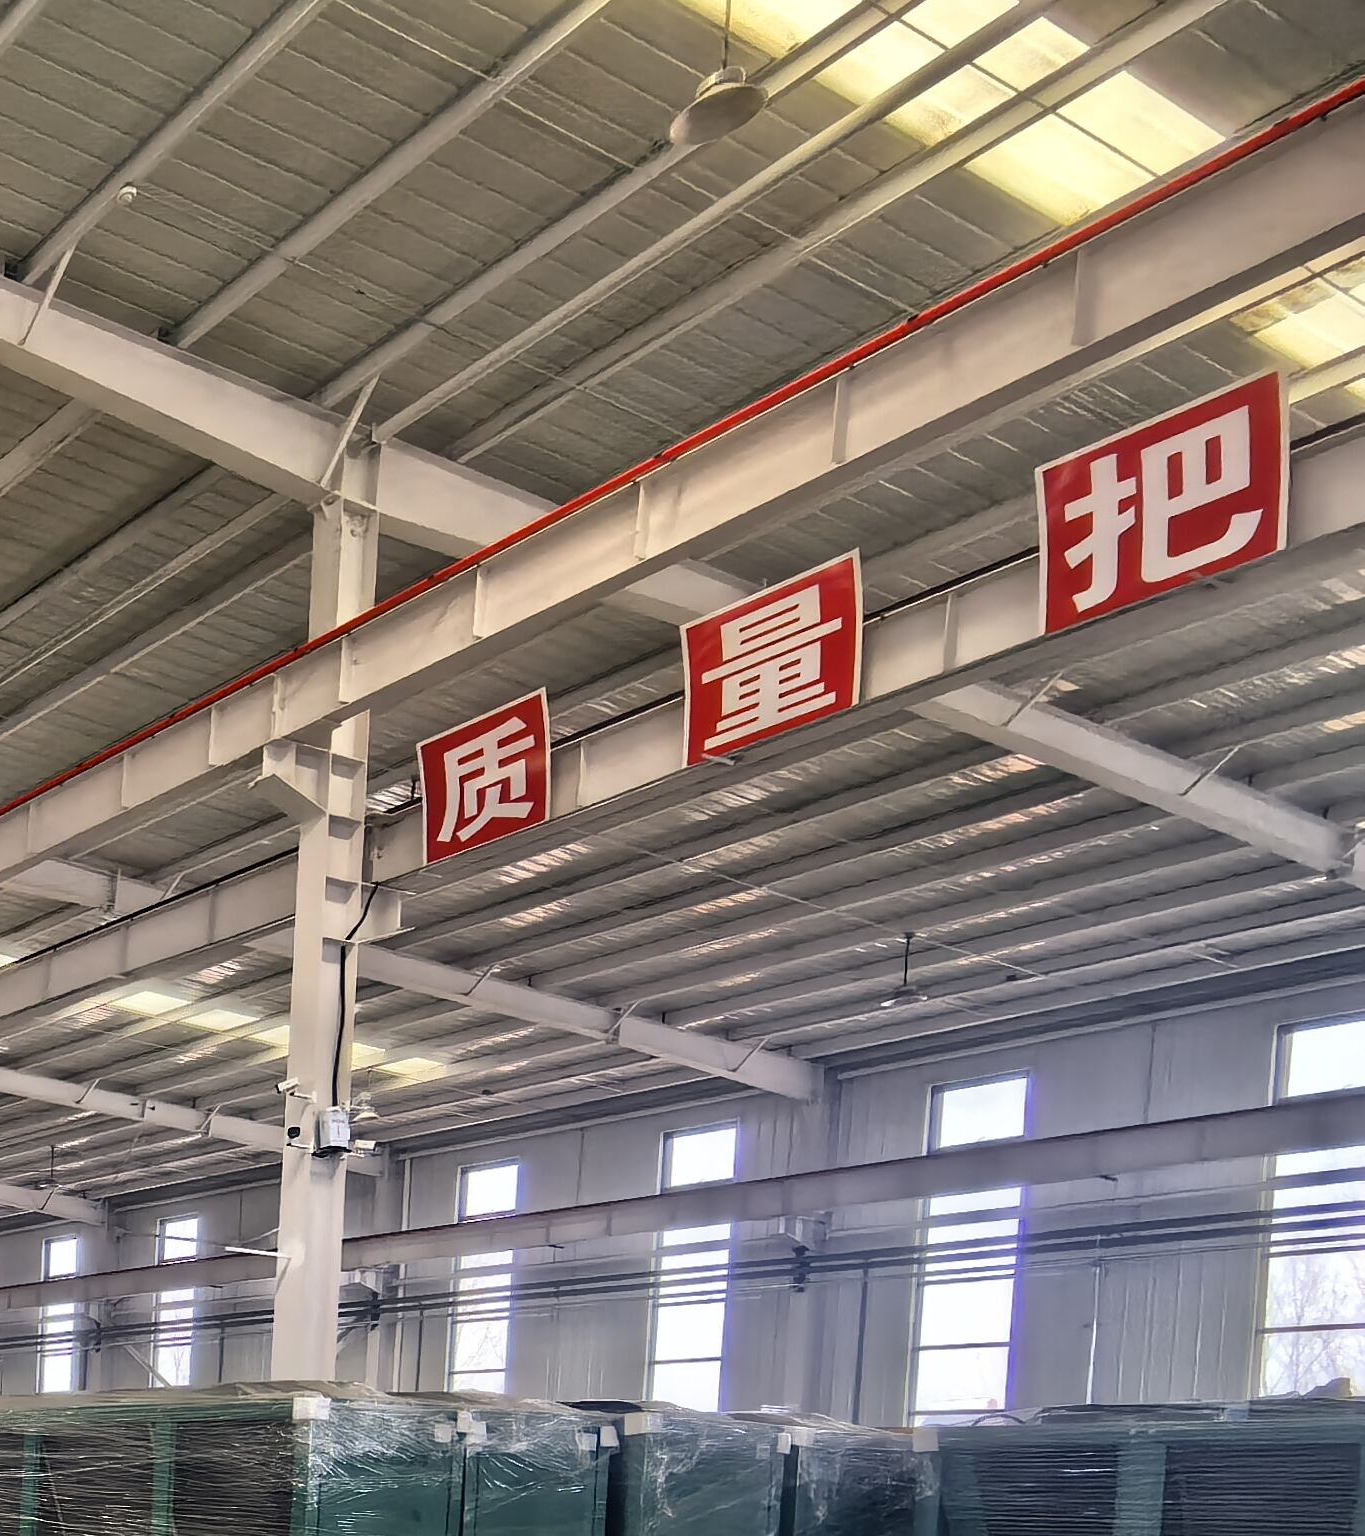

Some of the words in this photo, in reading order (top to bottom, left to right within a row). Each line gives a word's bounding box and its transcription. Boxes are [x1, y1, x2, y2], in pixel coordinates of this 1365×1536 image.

[436, 716, 538, 846] 质
[701, 582, 845, 754] 量
[1063, 403, 1266, 614] 把
